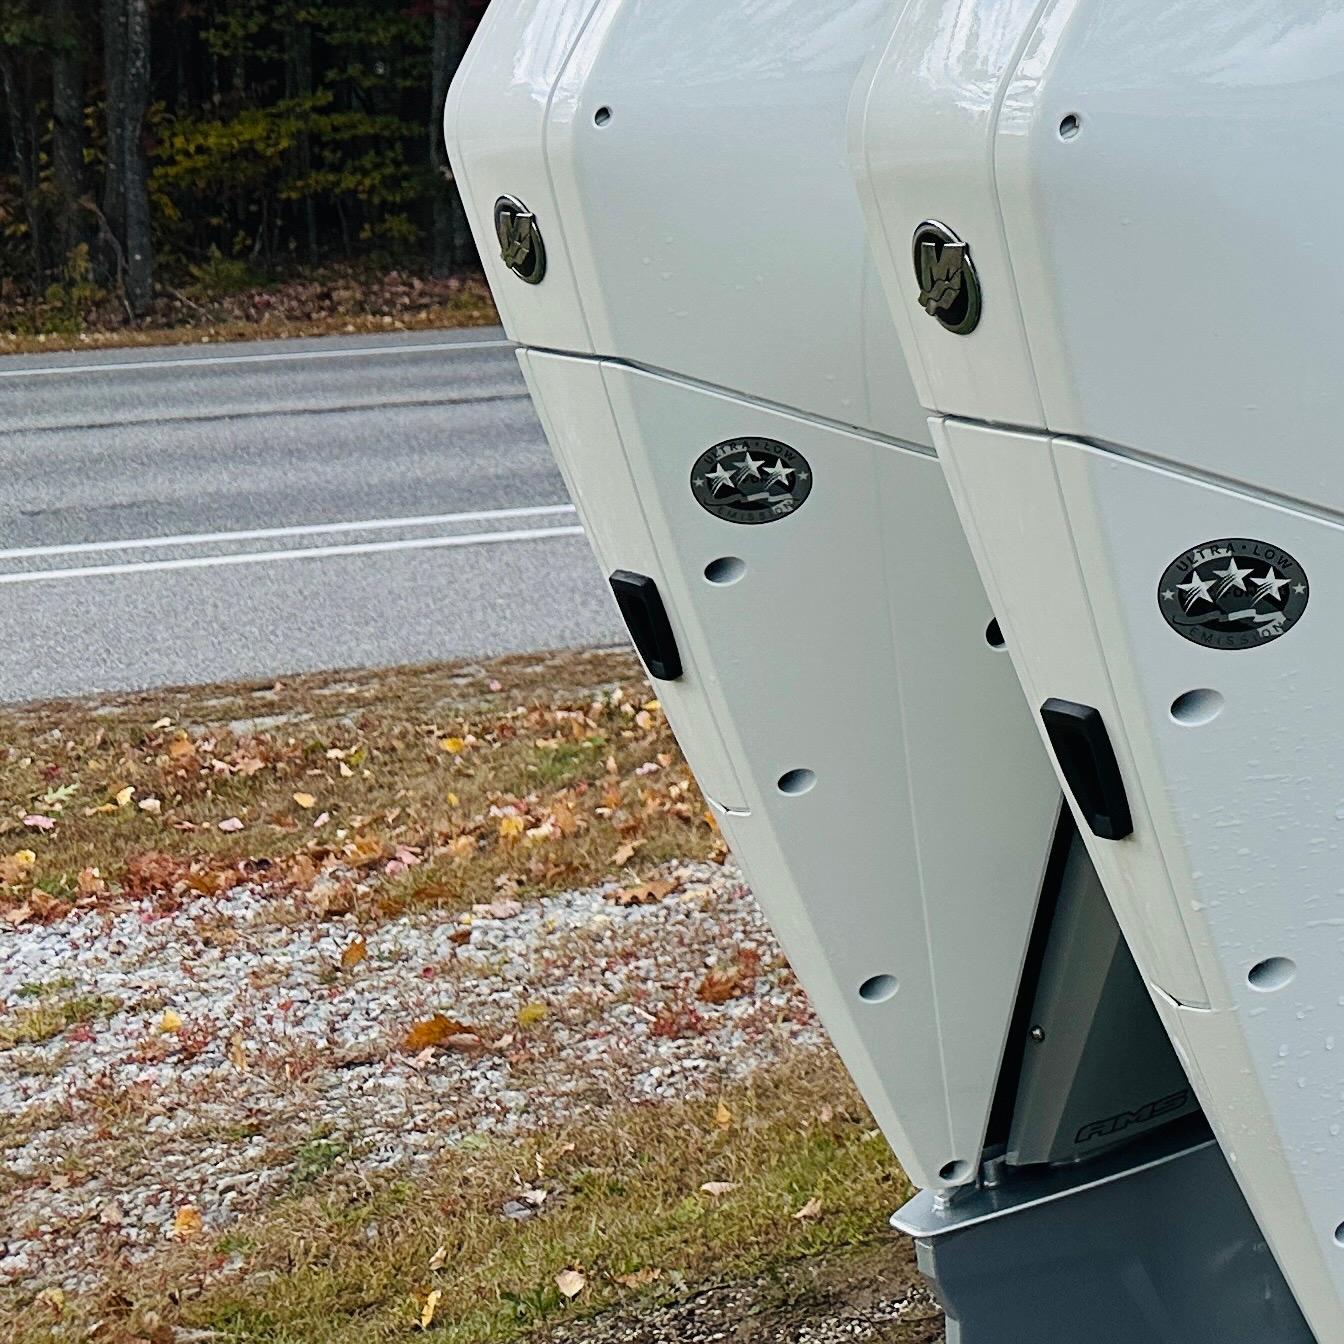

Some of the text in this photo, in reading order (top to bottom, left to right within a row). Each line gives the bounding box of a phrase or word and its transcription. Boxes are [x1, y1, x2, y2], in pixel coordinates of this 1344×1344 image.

[704, 441, 796, 465] ULTRA LOW
[1176, 542, 1293, 573] ULTRA LOW
